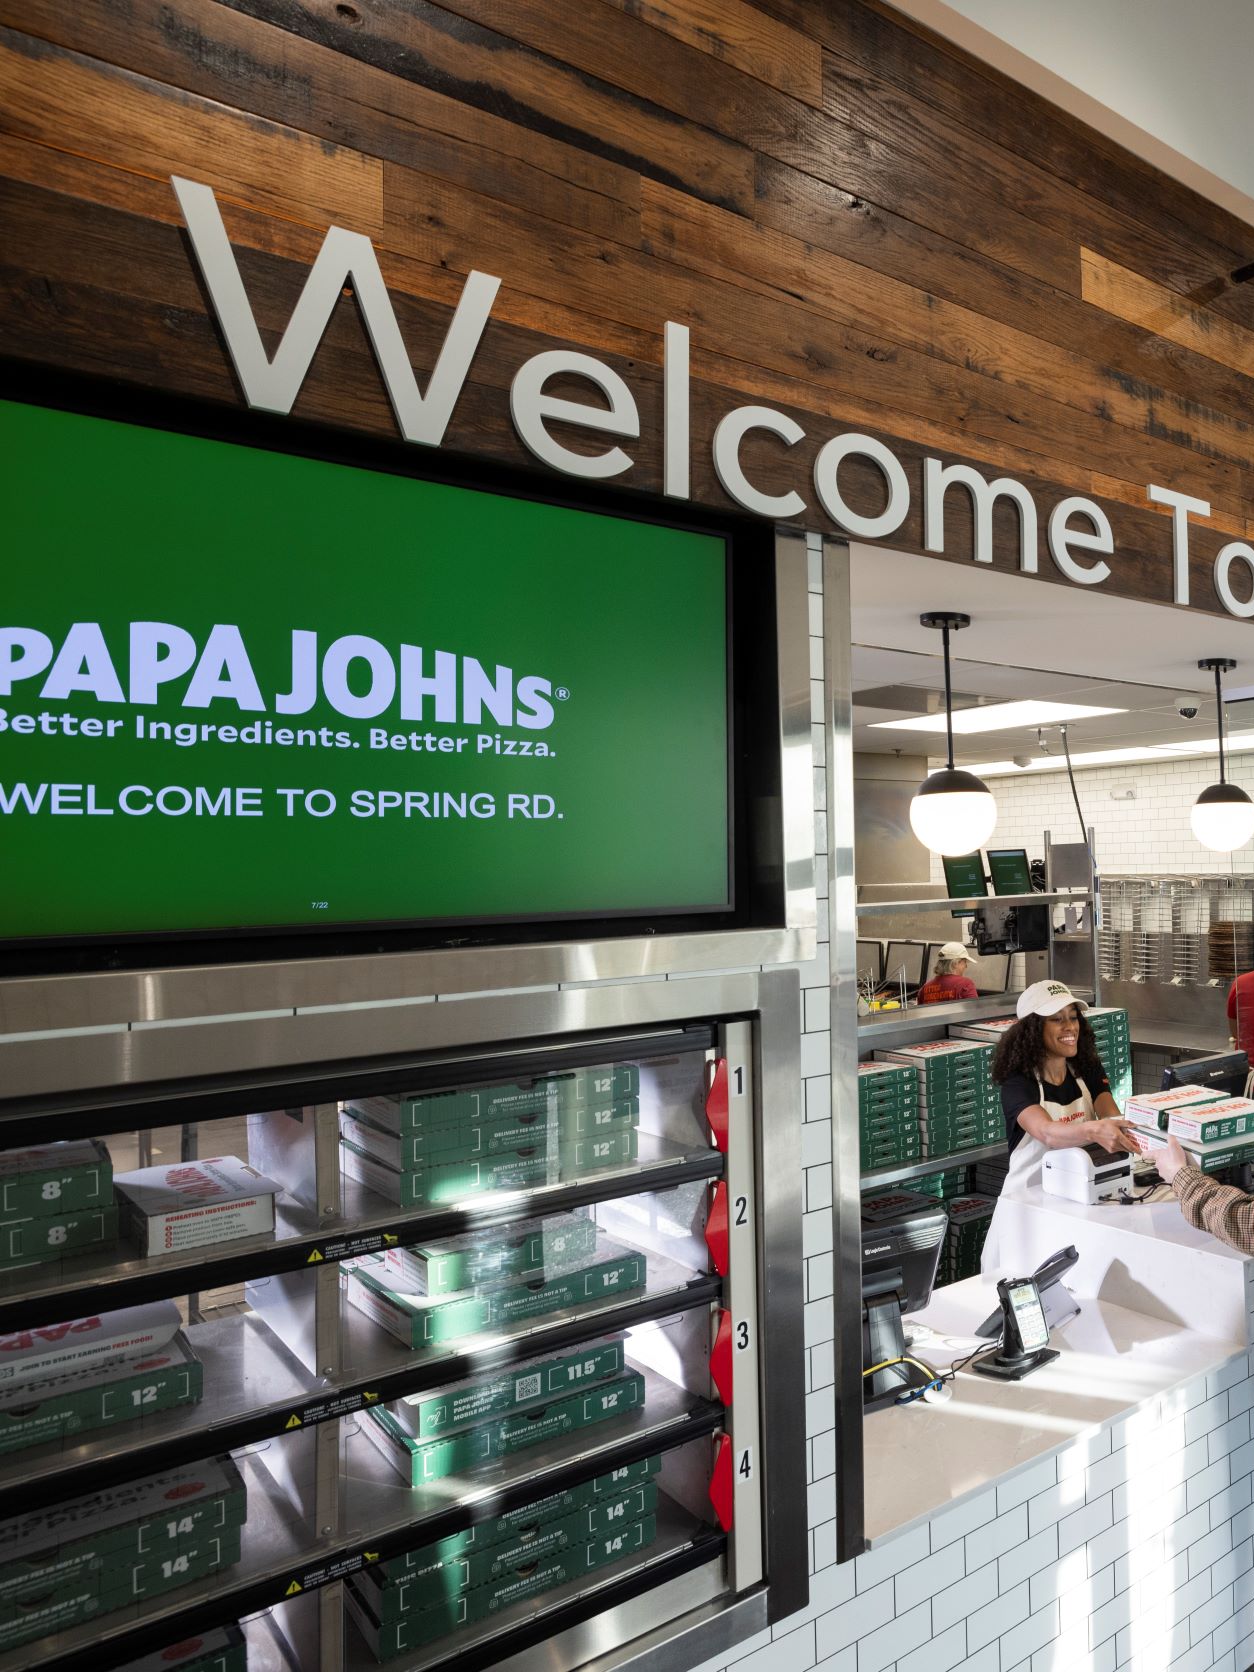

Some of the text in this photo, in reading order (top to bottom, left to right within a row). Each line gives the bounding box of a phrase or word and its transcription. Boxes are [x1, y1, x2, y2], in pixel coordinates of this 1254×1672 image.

[170, 174, 1114, 585] Welcome
[0, 622, 266, 711] PAPA
[136, 714, 360, 750] Ingredients.
[370, 728, 469, 754] Better
[477, 734, 556, 757] Pizza.
[0, 783, 564, 819] WELCOME TO SPRING RD.
[311, 901, 329, 909] 7/22
[594, 1076, 616, 1093] 12"
[734, 1066, 743, 1094] 1
[493, 1095, 518, 1104] DELIVERY
[595, 1108, 617, 1125] 12"
[494, 1129, 518, 1138] DELIVERY
[593, 1140, 615, 1157] 12"
[41, 1177, 73, 1200] 8"
[735, 1197, 747, 1225] 2
[47, 1222, 78, 1245] 8"
[603, 1268, 625, 1286] 12"
[504, 1297, 528, 1308] DELIVERY
[737, 1321, 749, 1349] 3
[20, 1362, 39, 1372] JOIN
[53, 1353, 76, 1364] START
[78, 1345, 111, 1358] EARNING
[112, 1340, 129, 1350] FREE
[567, 1357, 601, 1381] 11.5"
[131, 1382, 166, 1406] 12"
[601, 1390, 623, 1410] 12"
[34, 1416, 51, 1425] NOT
[59, 1410, 74, 1419] TIP
[453, 1404, 471, 1414] PAPA
[453, 1404, 491, 1422] MOBILE APP
[558, 1413, 567, 1421] TIP
[739, 1449, 751, 1476] 4
[502, 1506, 527, 1520] DELIVERY
[606, 1500, 630, 1521] 14"
[166, 1512, 203, 1539] 14"
[497, 1547, 522, 1561] DELIVERY
[538, 1536, 549, 1544] NOT
[554, 1529, 563, 1537] TIP
[605, 1533, 628, 1554] 14"
[81, 1551, 96, 1562] TIP
[161, 1550, 198, 1578] 14"
[494, 1582, 520, 1598] DELIVERY
[536, 1570, 547, 1579] NOT
[77, 1593, 90, 1603] TIP
